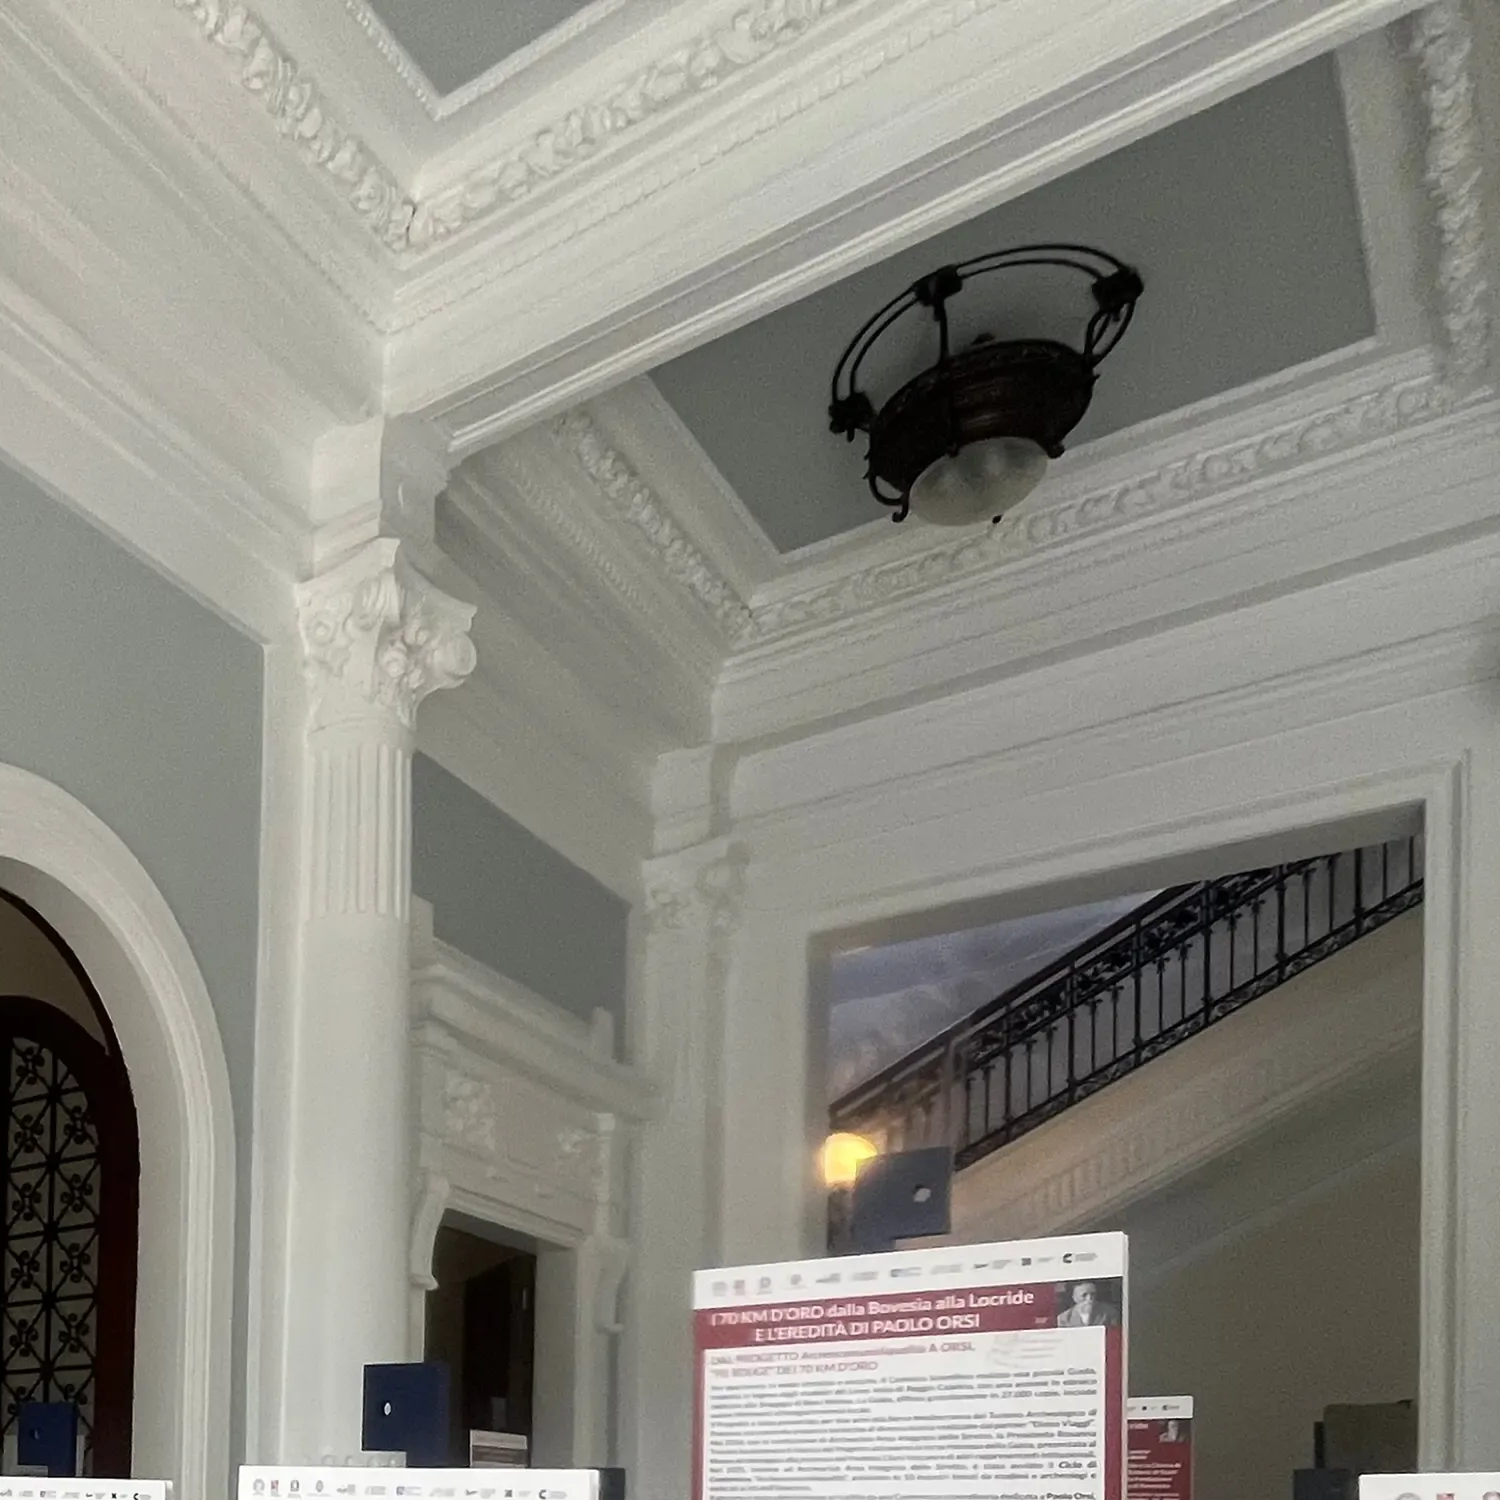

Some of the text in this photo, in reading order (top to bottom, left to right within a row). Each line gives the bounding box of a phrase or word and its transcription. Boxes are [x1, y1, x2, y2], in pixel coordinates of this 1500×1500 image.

[715, 1290, 1033, 1325] 70 KM D'ORO dalla Bovesia alla Locride
[755, 1314, 979, 1341] E L'EREDITÀ DI PAOLO ORSI
